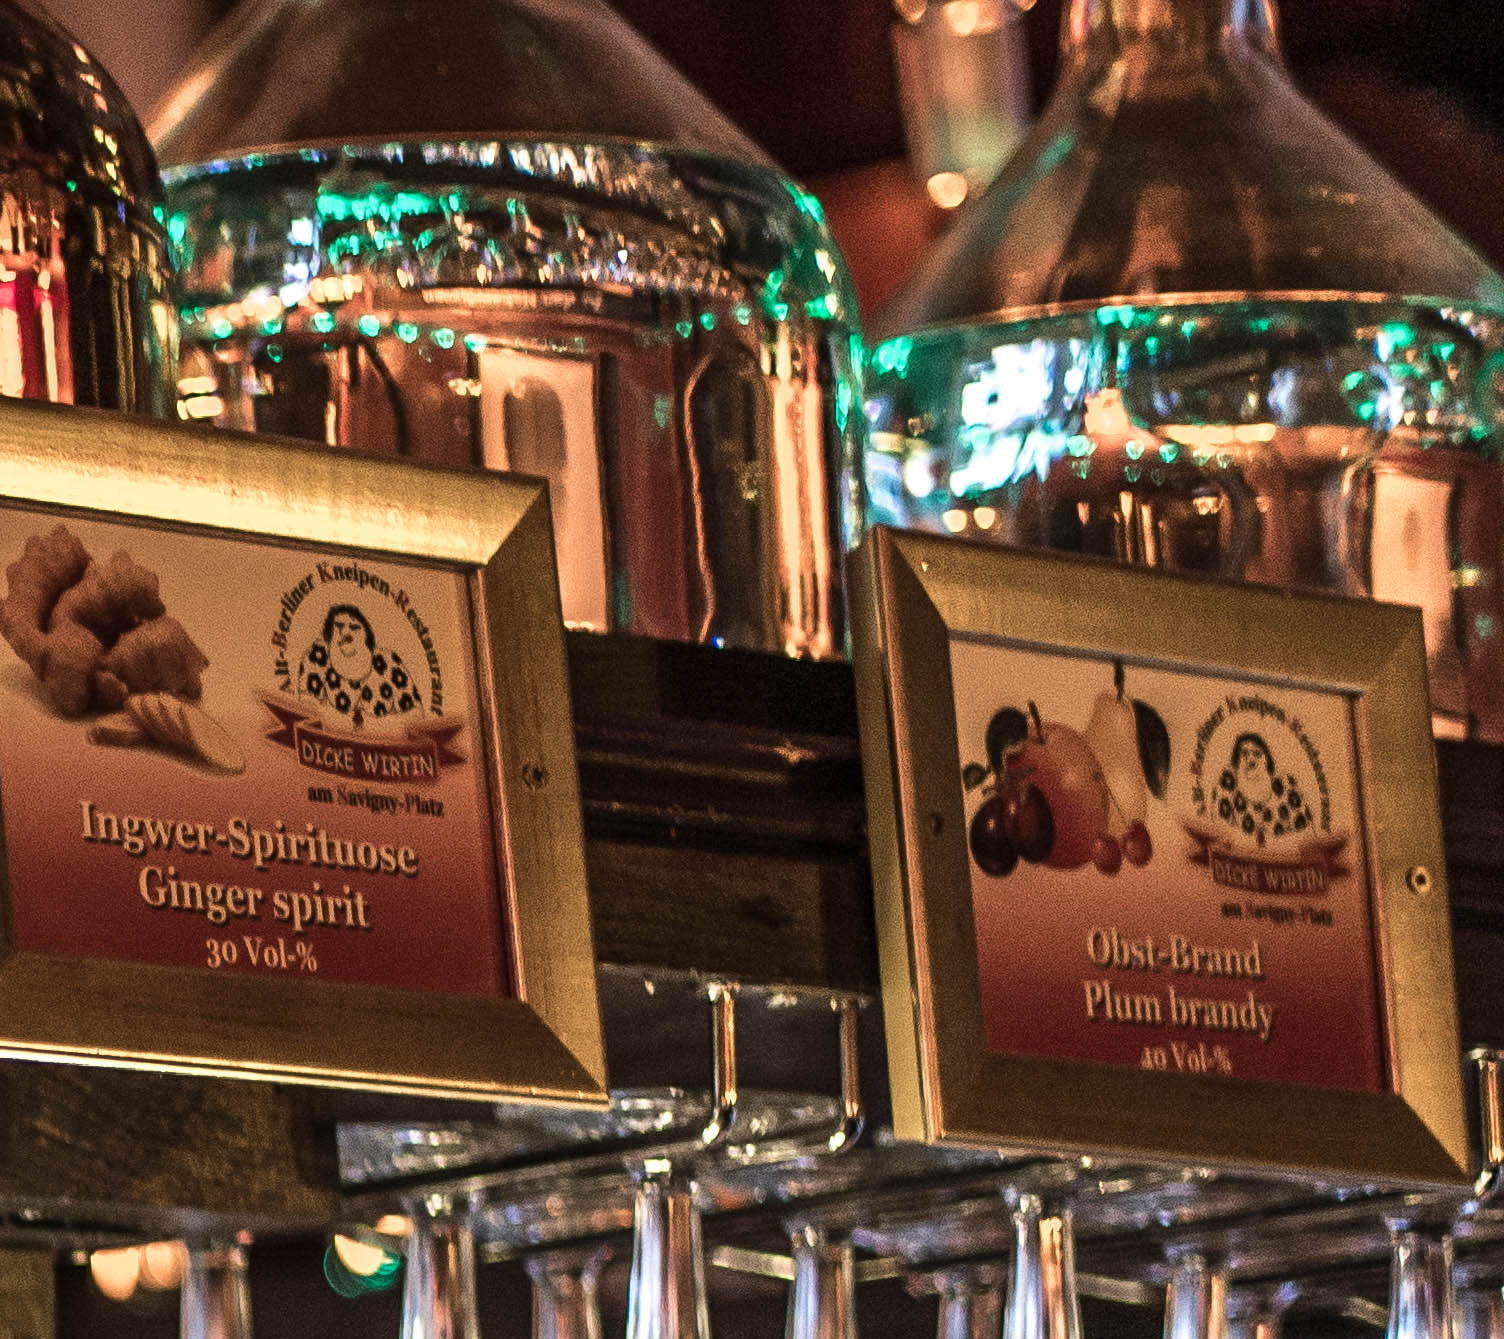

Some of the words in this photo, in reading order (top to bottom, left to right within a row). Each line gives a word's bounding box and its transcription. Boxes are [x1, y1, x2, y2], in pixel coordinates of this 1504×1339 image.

[302, 741, 355, 770] DICKE
[362, 755, 435, 778] WIRTIN
[79, 801, 420, 877] Ingwer-Spirituose
[137, 866, 266, 924] Ginger
[272, 882, 372, 933] spirit
[205, 938, 238, 969] 30
[245, 938, 319, 974] Vol-%
[1087, 927, 1266, 980] Obst-Brand
[1084, 978, 1163, 1027] Plum
[1167, 984, 1274, 1043] brandy
